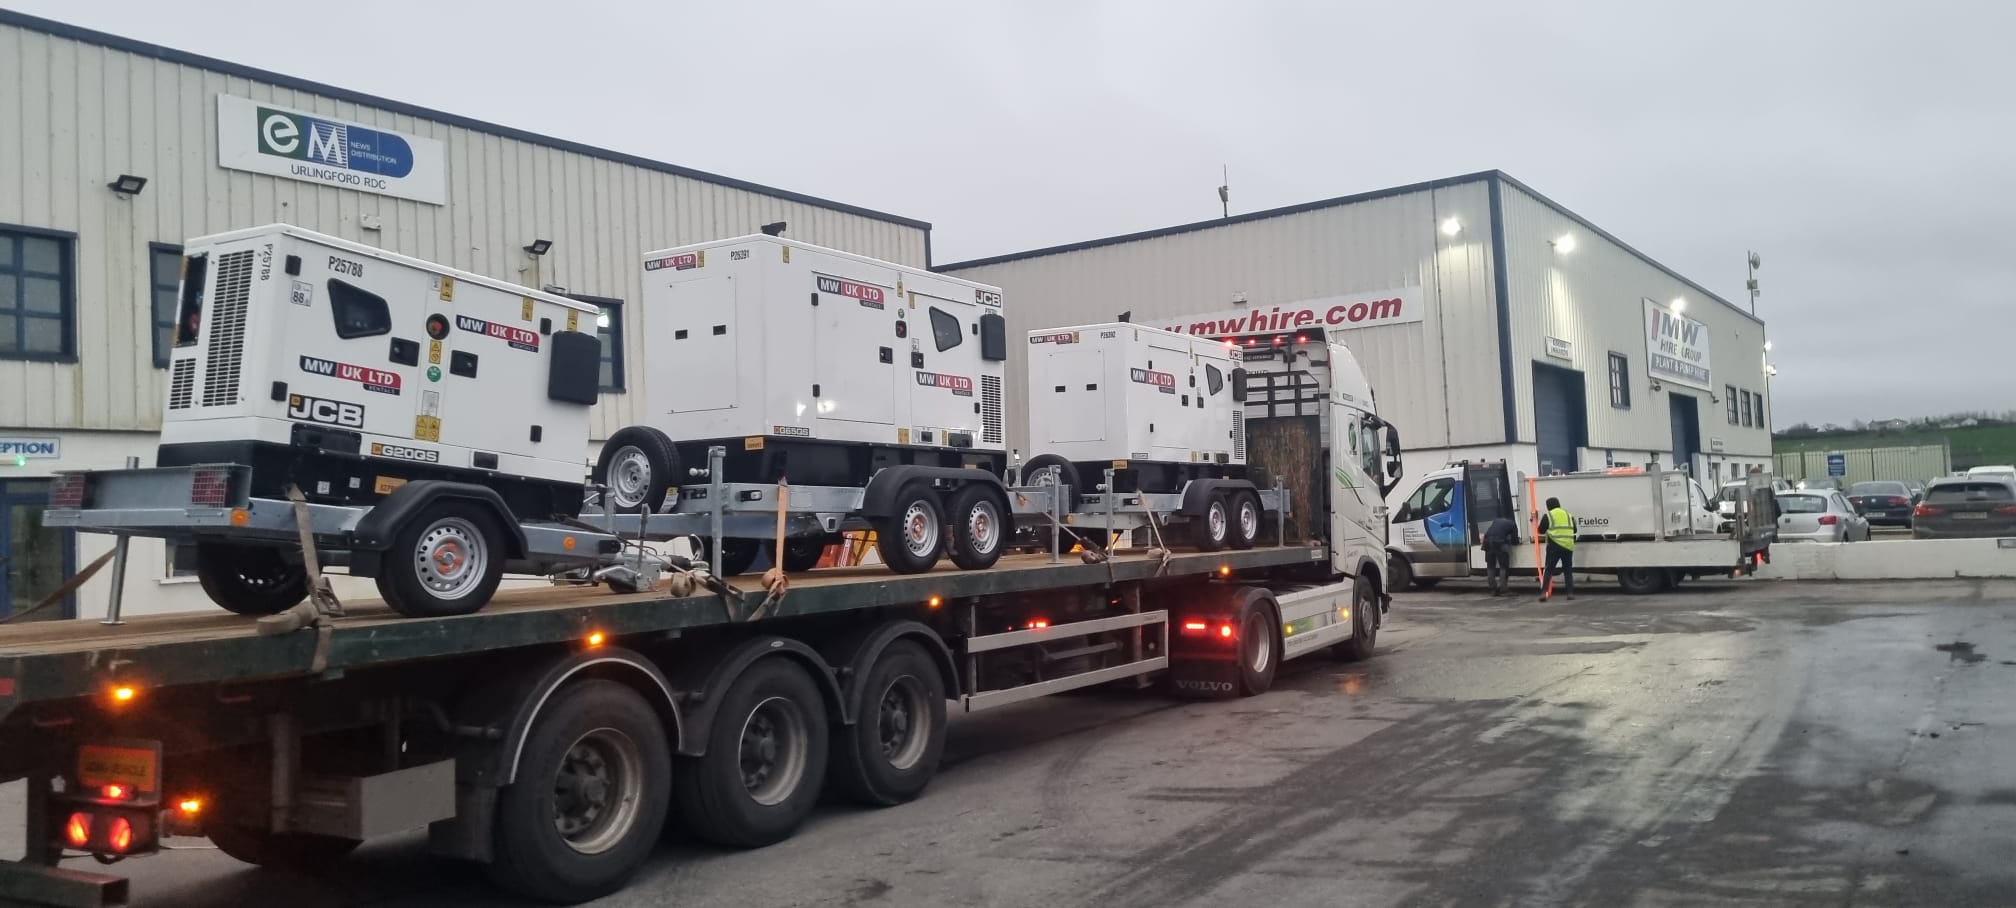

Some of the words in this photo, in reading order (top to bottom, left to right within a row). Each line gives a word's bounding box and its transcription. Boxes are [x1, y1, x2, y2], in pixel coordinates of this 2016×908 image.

[350, 141, 371, 151] NEWS
[350, 150, 397, 165] DISTRIBUTION
[291, 164, 361, 185] URLINGFORD
[364, 176, 387, 190] RDC
[260, 243, 274, 281] P25788
[327, 255, 364, 278] P25788
[646, 259, 662, 271] MW
[664, 257, 675, 267] UK
[678, 254, 693, 265] LTD
[819, 278, 840, 293] MW
[844, 283, 859, 297] UK
[861, 286, 879, 300] LTD
[976, 291, 1001, 307] JCB
[1164, 297, 1402, 337] mwhire.com
[460, 317, 485, 332] MW
[490, 324, 508, 338] UK
[511, 328, 533, 343] LTD
[1661, 312, 1699, 346] MW
[1229, 350, 1243, 360] JCB
[1660, 339, 1678, 355] HIRE
[304, 358, 334, 375] MW
[342, 366, 363, 380] UK
[368, 370, 394, 385] LTD
[1655, 356, 1674, 370] PLANT
[919, 372, 936, 386] MW
[939, 375, 951, 387] UK
[954, 377, 968, 389] LTD
[1131, 369, 1146, 382] MW
[1148, 372, 1159, 384] UK
[1160, 374, 1173, 387] LTD
[289, 397, 363, 427] JCB
[1578, 516, 1609, 525] Fuelco
[1175, 679, 1233, 692] VOLVO
